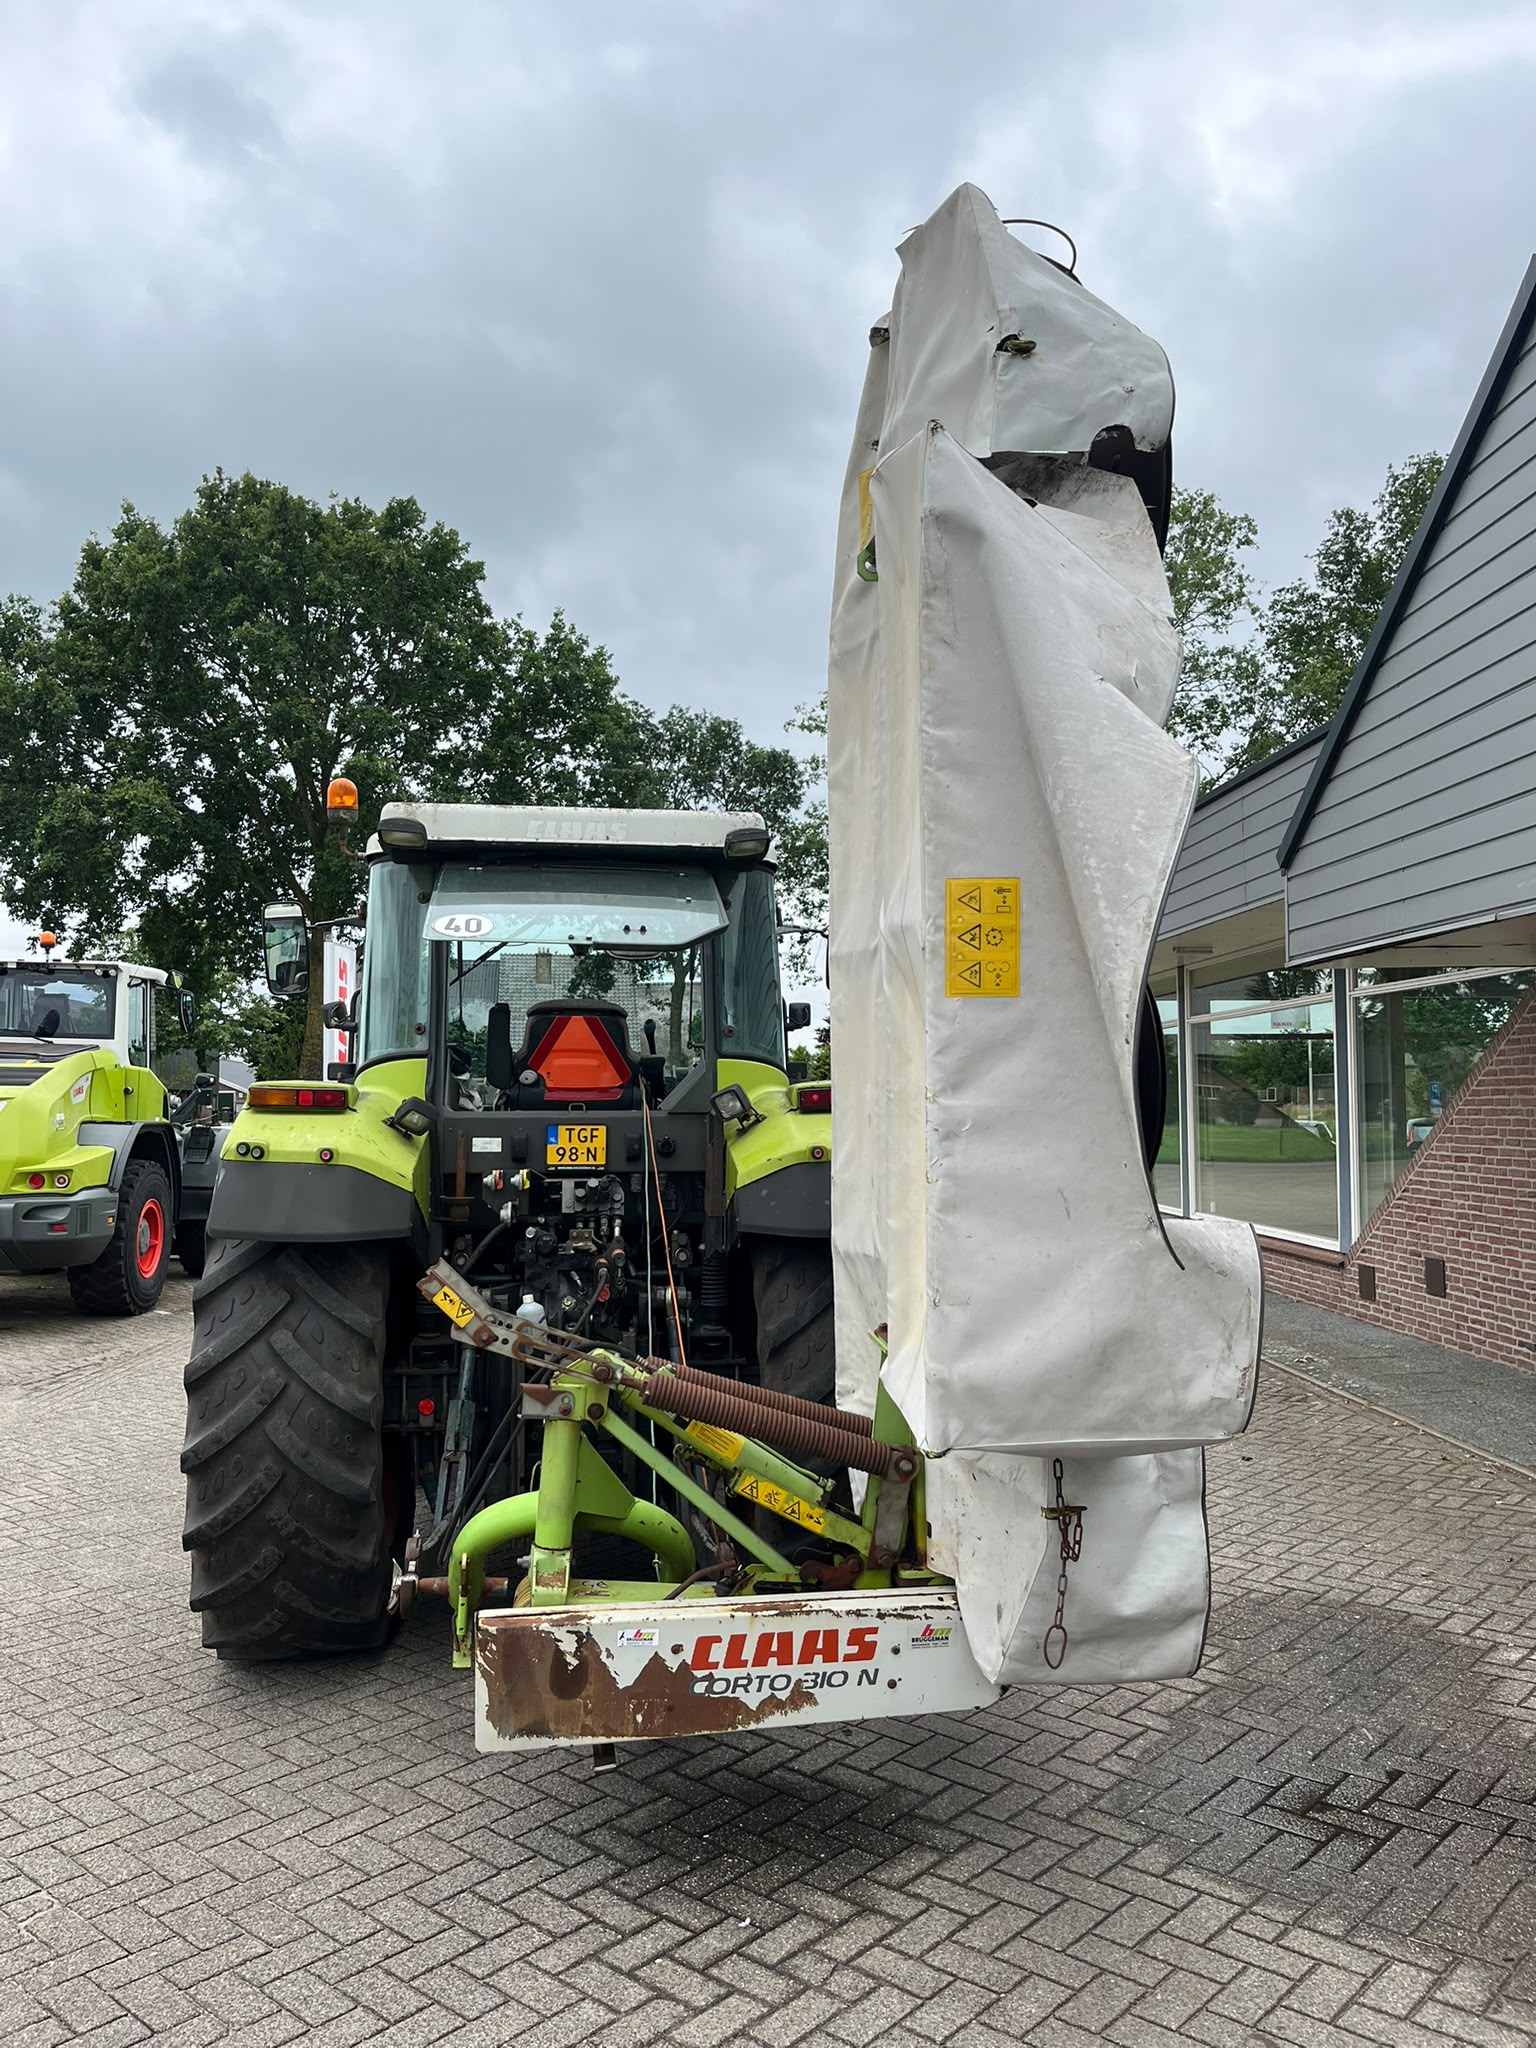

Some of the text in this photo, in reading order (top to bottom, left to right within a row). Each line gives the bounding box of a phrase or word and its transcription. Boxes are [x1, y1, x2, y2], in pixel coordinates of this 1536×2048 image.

[526, 820, 629, 840] CLAAS
[444, 917, 482, 933] 40
[565, 1127, 600, 1144] TGF
[555, 1146, 598, 1162] 98-N
[911, 1635, 949, 1643] BRUGGEMAN
[689, 1626, 880, 1671] CLAAS
[689, 1673, 792, 1697] CORTO
[857, 1668, 880, 1687] N
